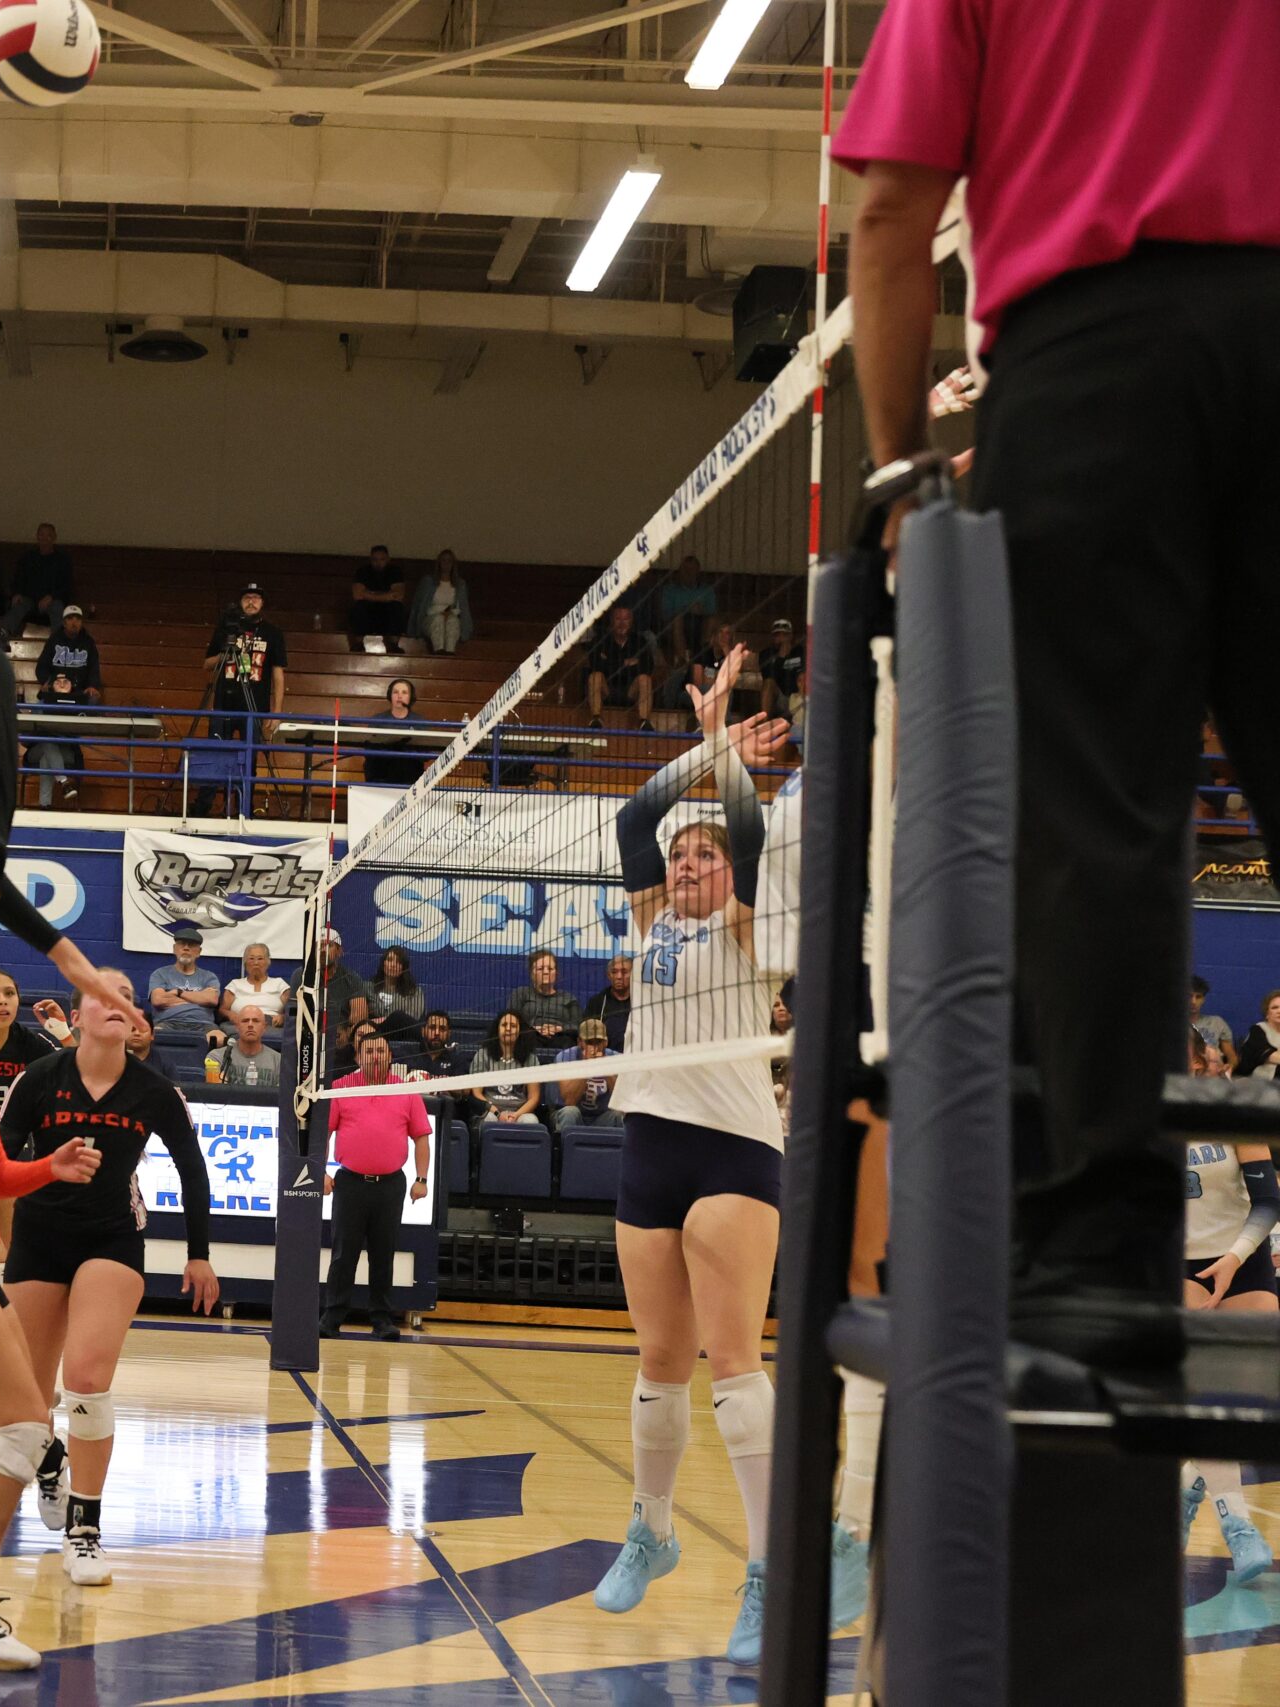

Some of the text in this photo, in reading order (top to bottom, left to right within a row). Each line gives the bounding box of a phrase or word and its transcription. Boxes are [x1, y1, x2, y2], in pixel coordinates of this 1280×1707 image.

[151, 849, 324, 899] Rockets
[642, 943, 685, 986] 15
[299, 1190, 321, 1199] SPORTS
